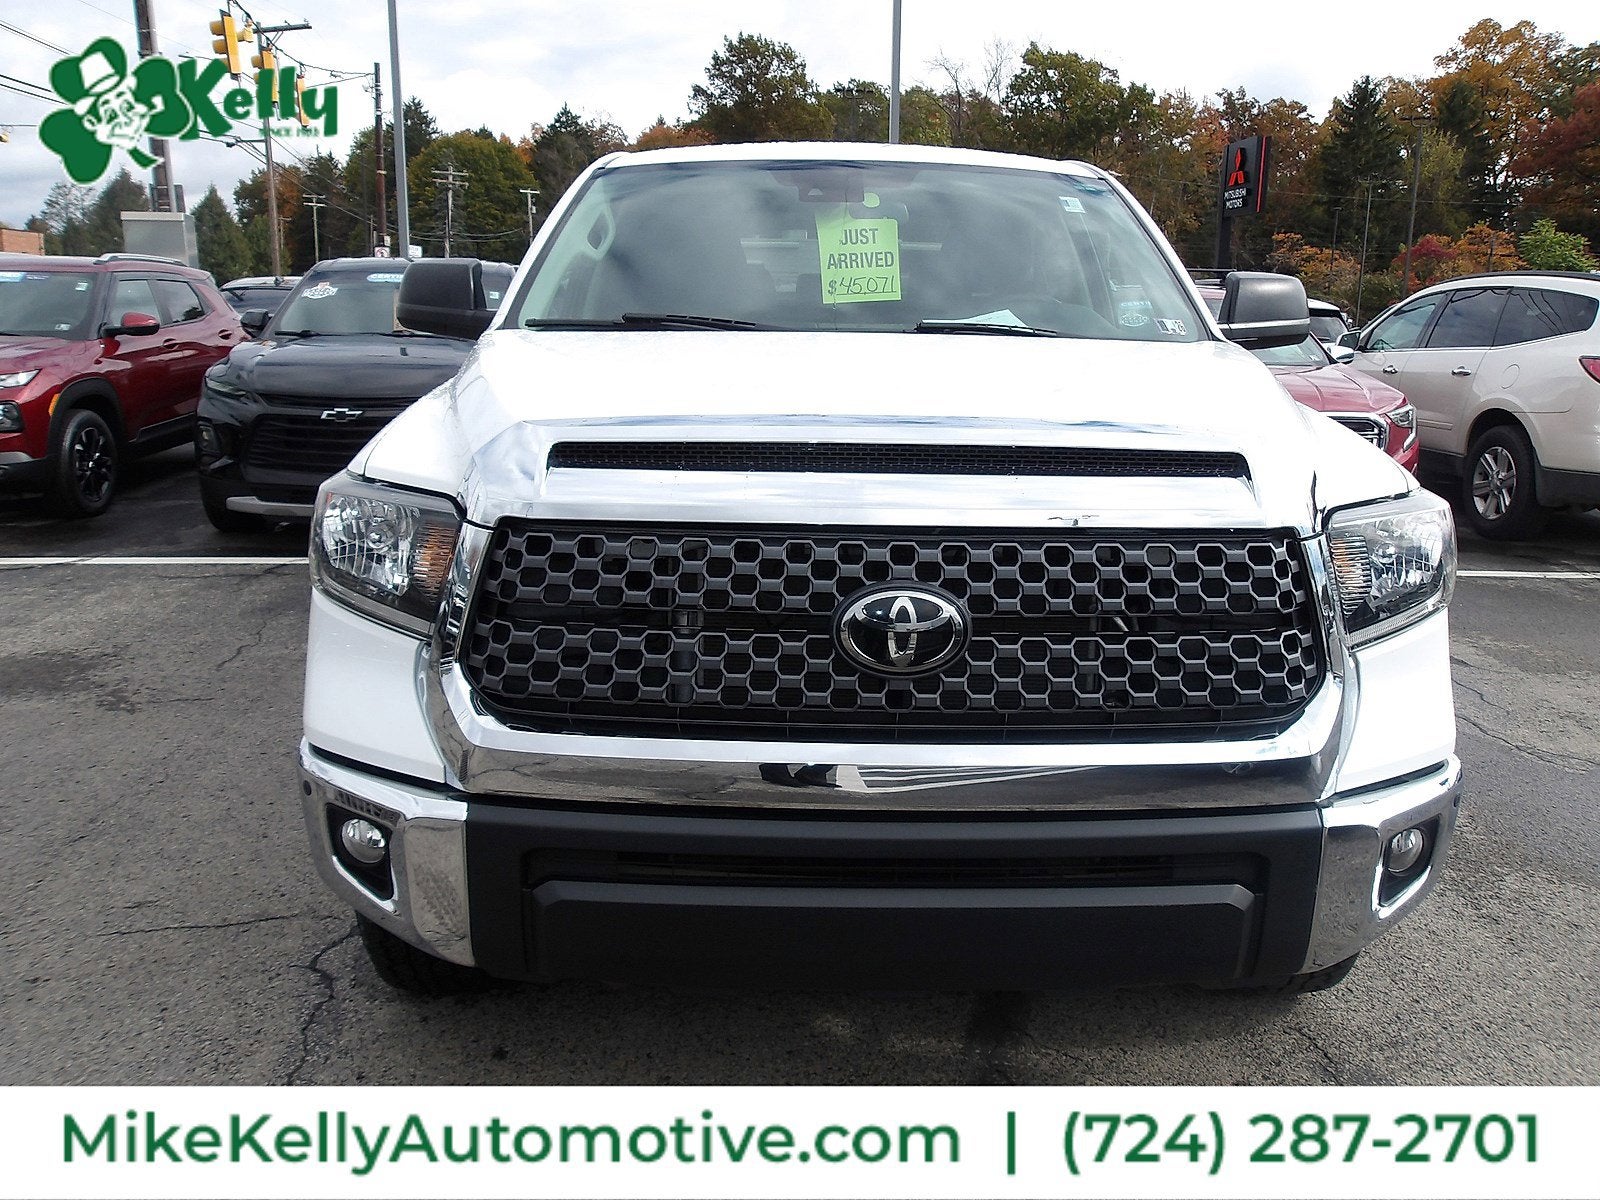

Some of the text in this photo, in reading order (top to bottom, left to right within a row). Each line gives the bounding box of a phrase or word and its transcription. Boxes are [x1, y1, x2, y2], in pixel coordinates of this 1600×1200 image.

[1223, 187, 1247, 200] MITSUBISHI
[1225, 198, 1243, 210] MOTORS
[840, 228, 879, 245] JUST
[827, 251, 895, 269] ARRIVED
